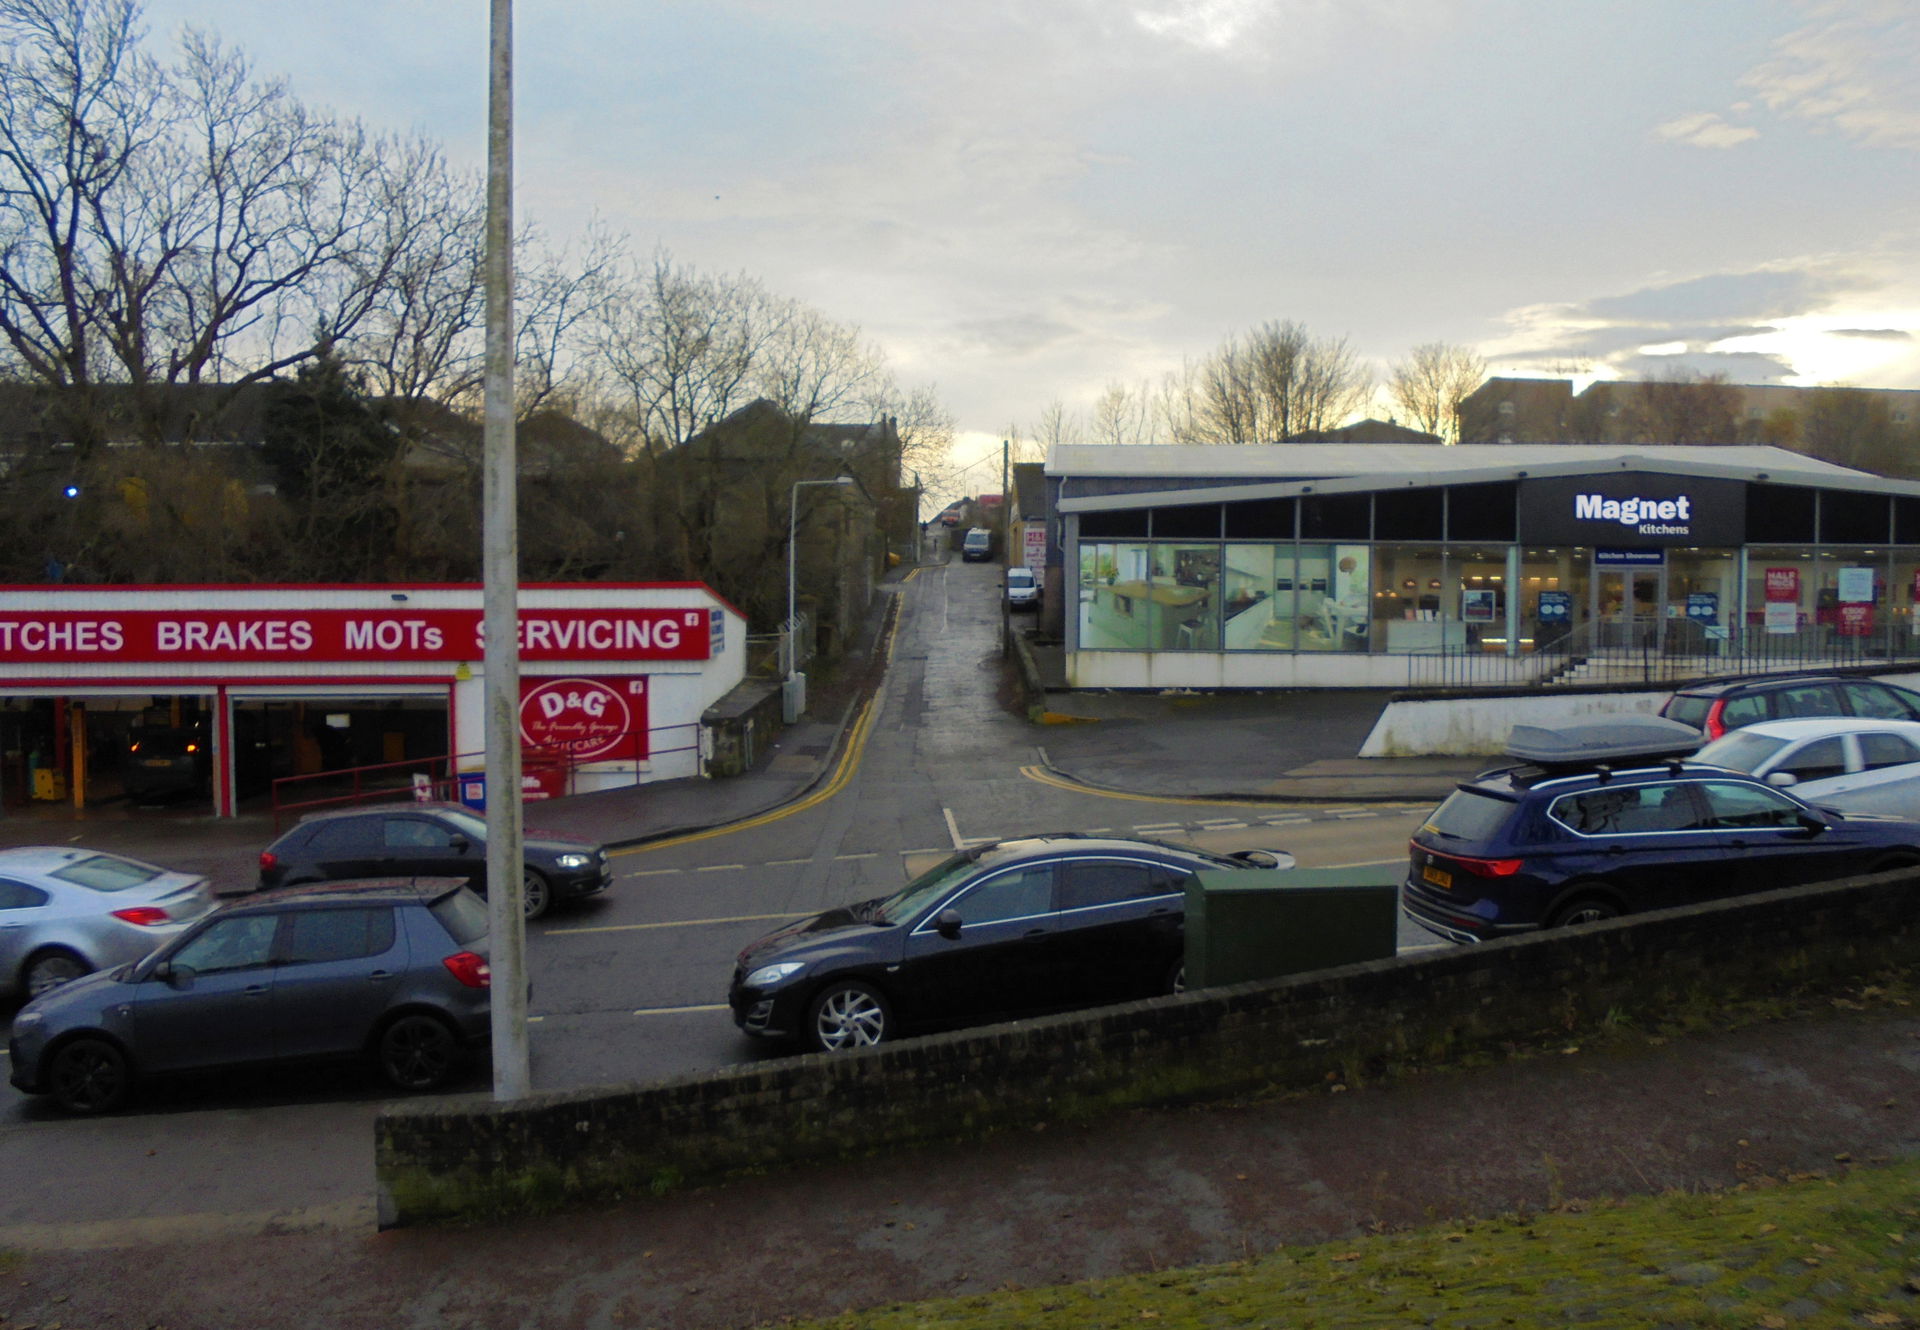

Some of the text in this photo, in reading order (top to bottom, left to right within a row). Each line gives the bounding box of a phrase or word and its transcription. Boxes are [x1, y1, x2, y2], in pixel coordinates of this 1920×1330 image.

[1576, 494, 1690, 525] Magnet
[1638, 523, 1690, 535] Kitchens
[157, 620, 313, 651] BRAKES
[345, 620, 444, 651] MOTs
[539, 691, 607, 719] D&G
